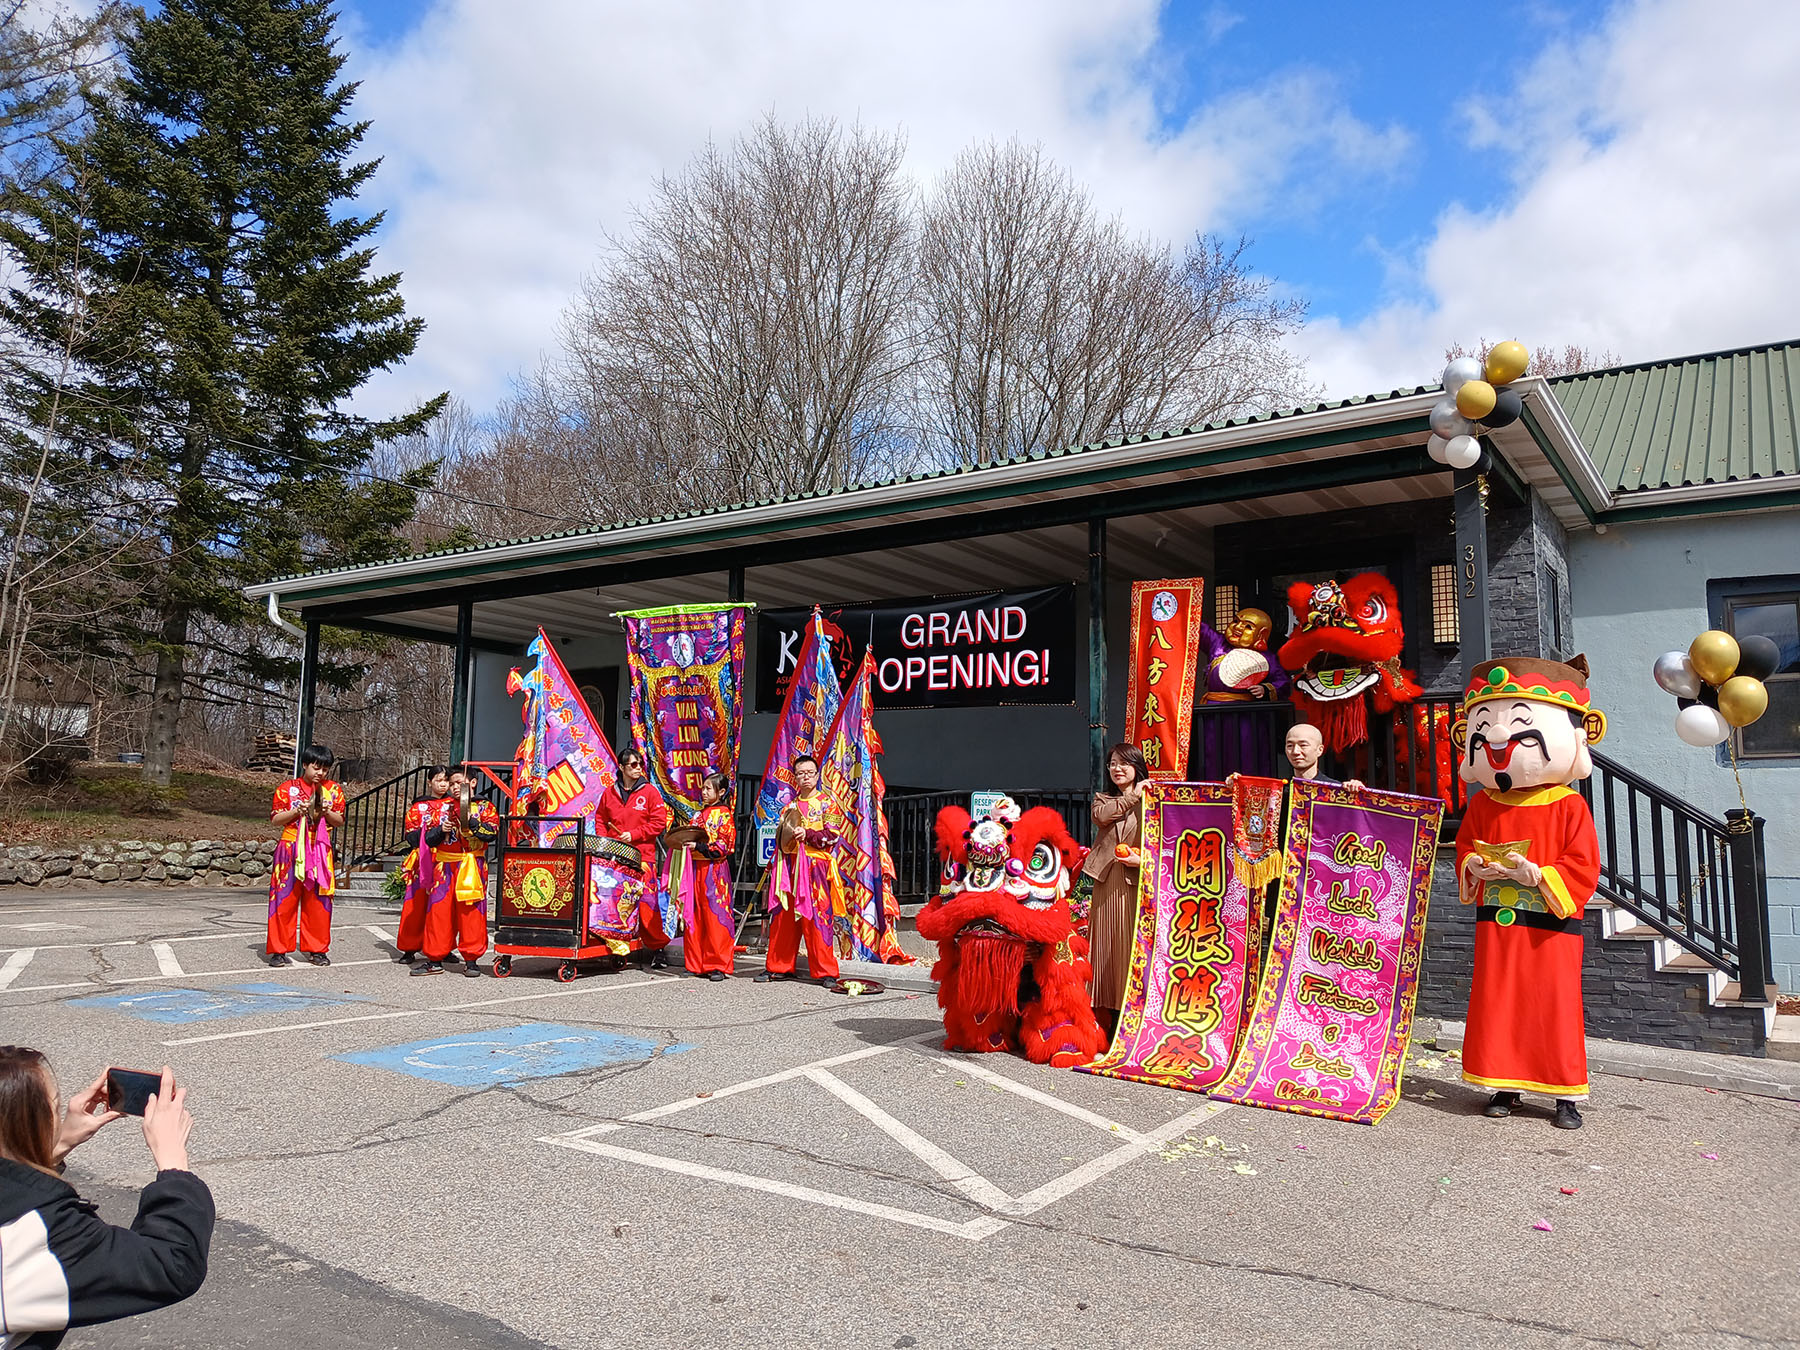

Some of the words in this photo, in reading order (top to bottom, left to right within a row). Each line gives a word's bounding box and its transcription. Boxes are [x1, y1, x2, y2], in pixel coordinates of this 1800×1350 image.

[1464, 544, 1476, 598] 302
[900, 606, 1027, 649] GRAND
[878, 649, 1050, 693] OPENING!
[675, 701, 698, 720] WAH
[1141, 625, 1173, 768] 八方來財
[678, 725, 700, 743] LUM
[794, 735, 809, 753] TAI
[672, 750, 709, 767] KUNG
[686, 773, 703, 790] FU
[545, 824, 564, 841] SIFU
[581, 801, 596, 817] DU
[1335, 833, 1385, 870] Good
[1328, 883, 1377, 919] Luck
[1146, 829, 1232, 1078] 開張鴻發
[1311, 929, 1381, 970] Wealth
[1300, 974, 1379, 1014] Fortune
[1290, 1042, 1353, 1078] Best
